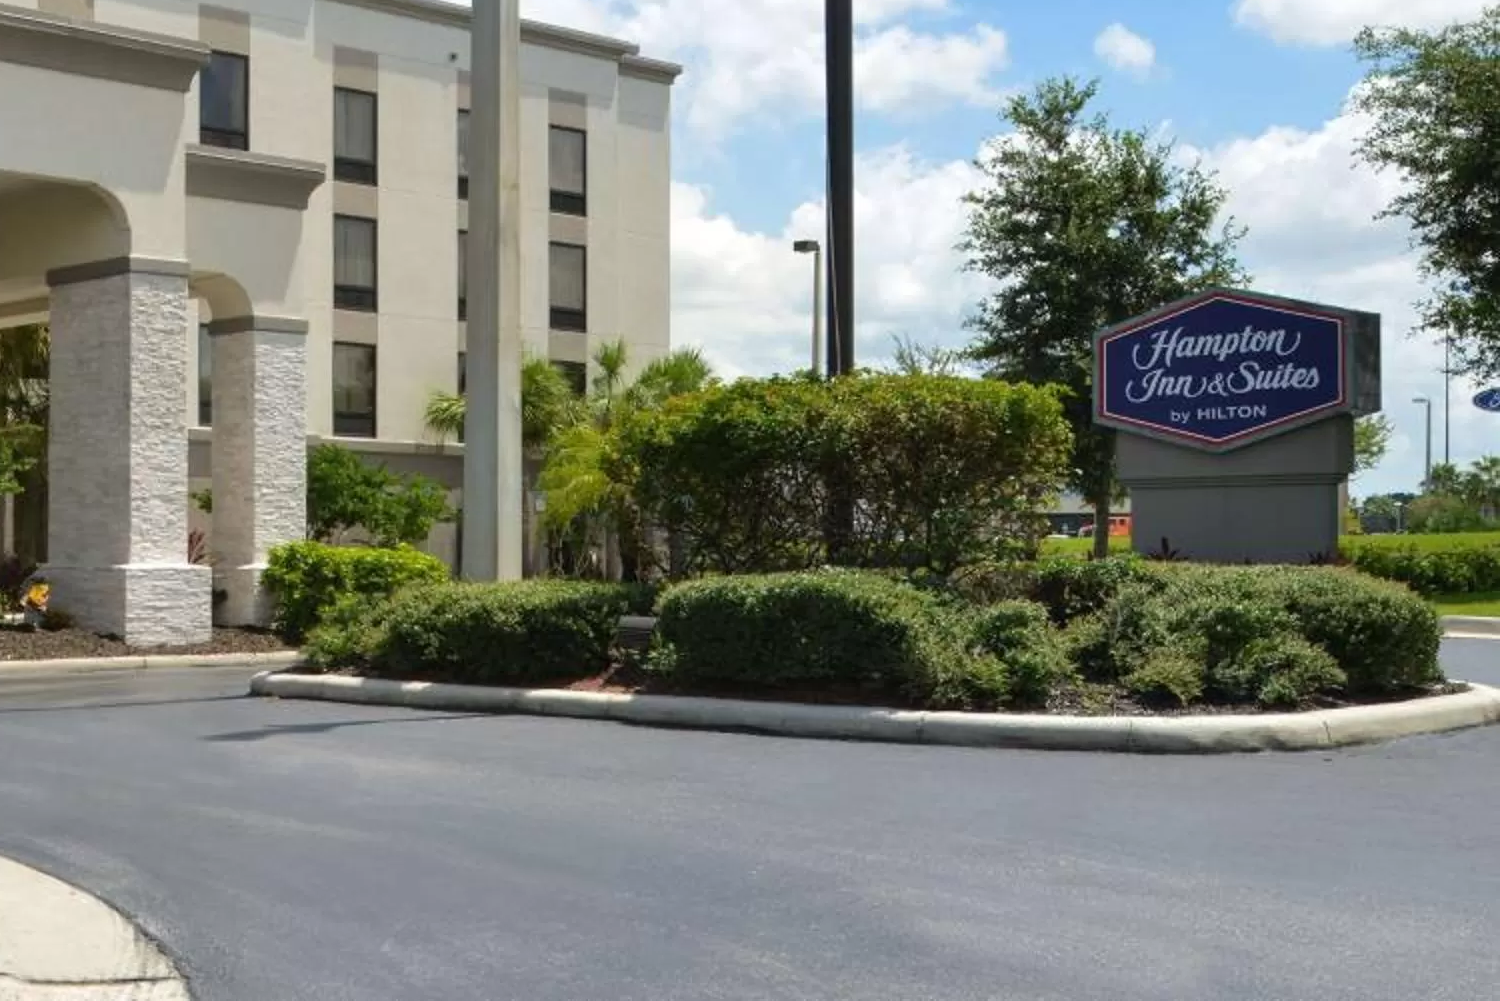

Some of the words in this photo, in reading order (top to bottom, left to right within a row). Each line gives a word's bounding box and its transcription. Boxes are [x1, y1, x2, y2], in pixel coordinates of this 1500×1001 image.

[1132, 326, 1301, 370] Hampton
[1125, 368, 1207, 403] Inn
[1207, 372, 1229, 397] &
[1227, 361, 1320, 394] Suites
[1170, 410, 1191, 424] by
[1197, 404, 1268, 420] HILTON
